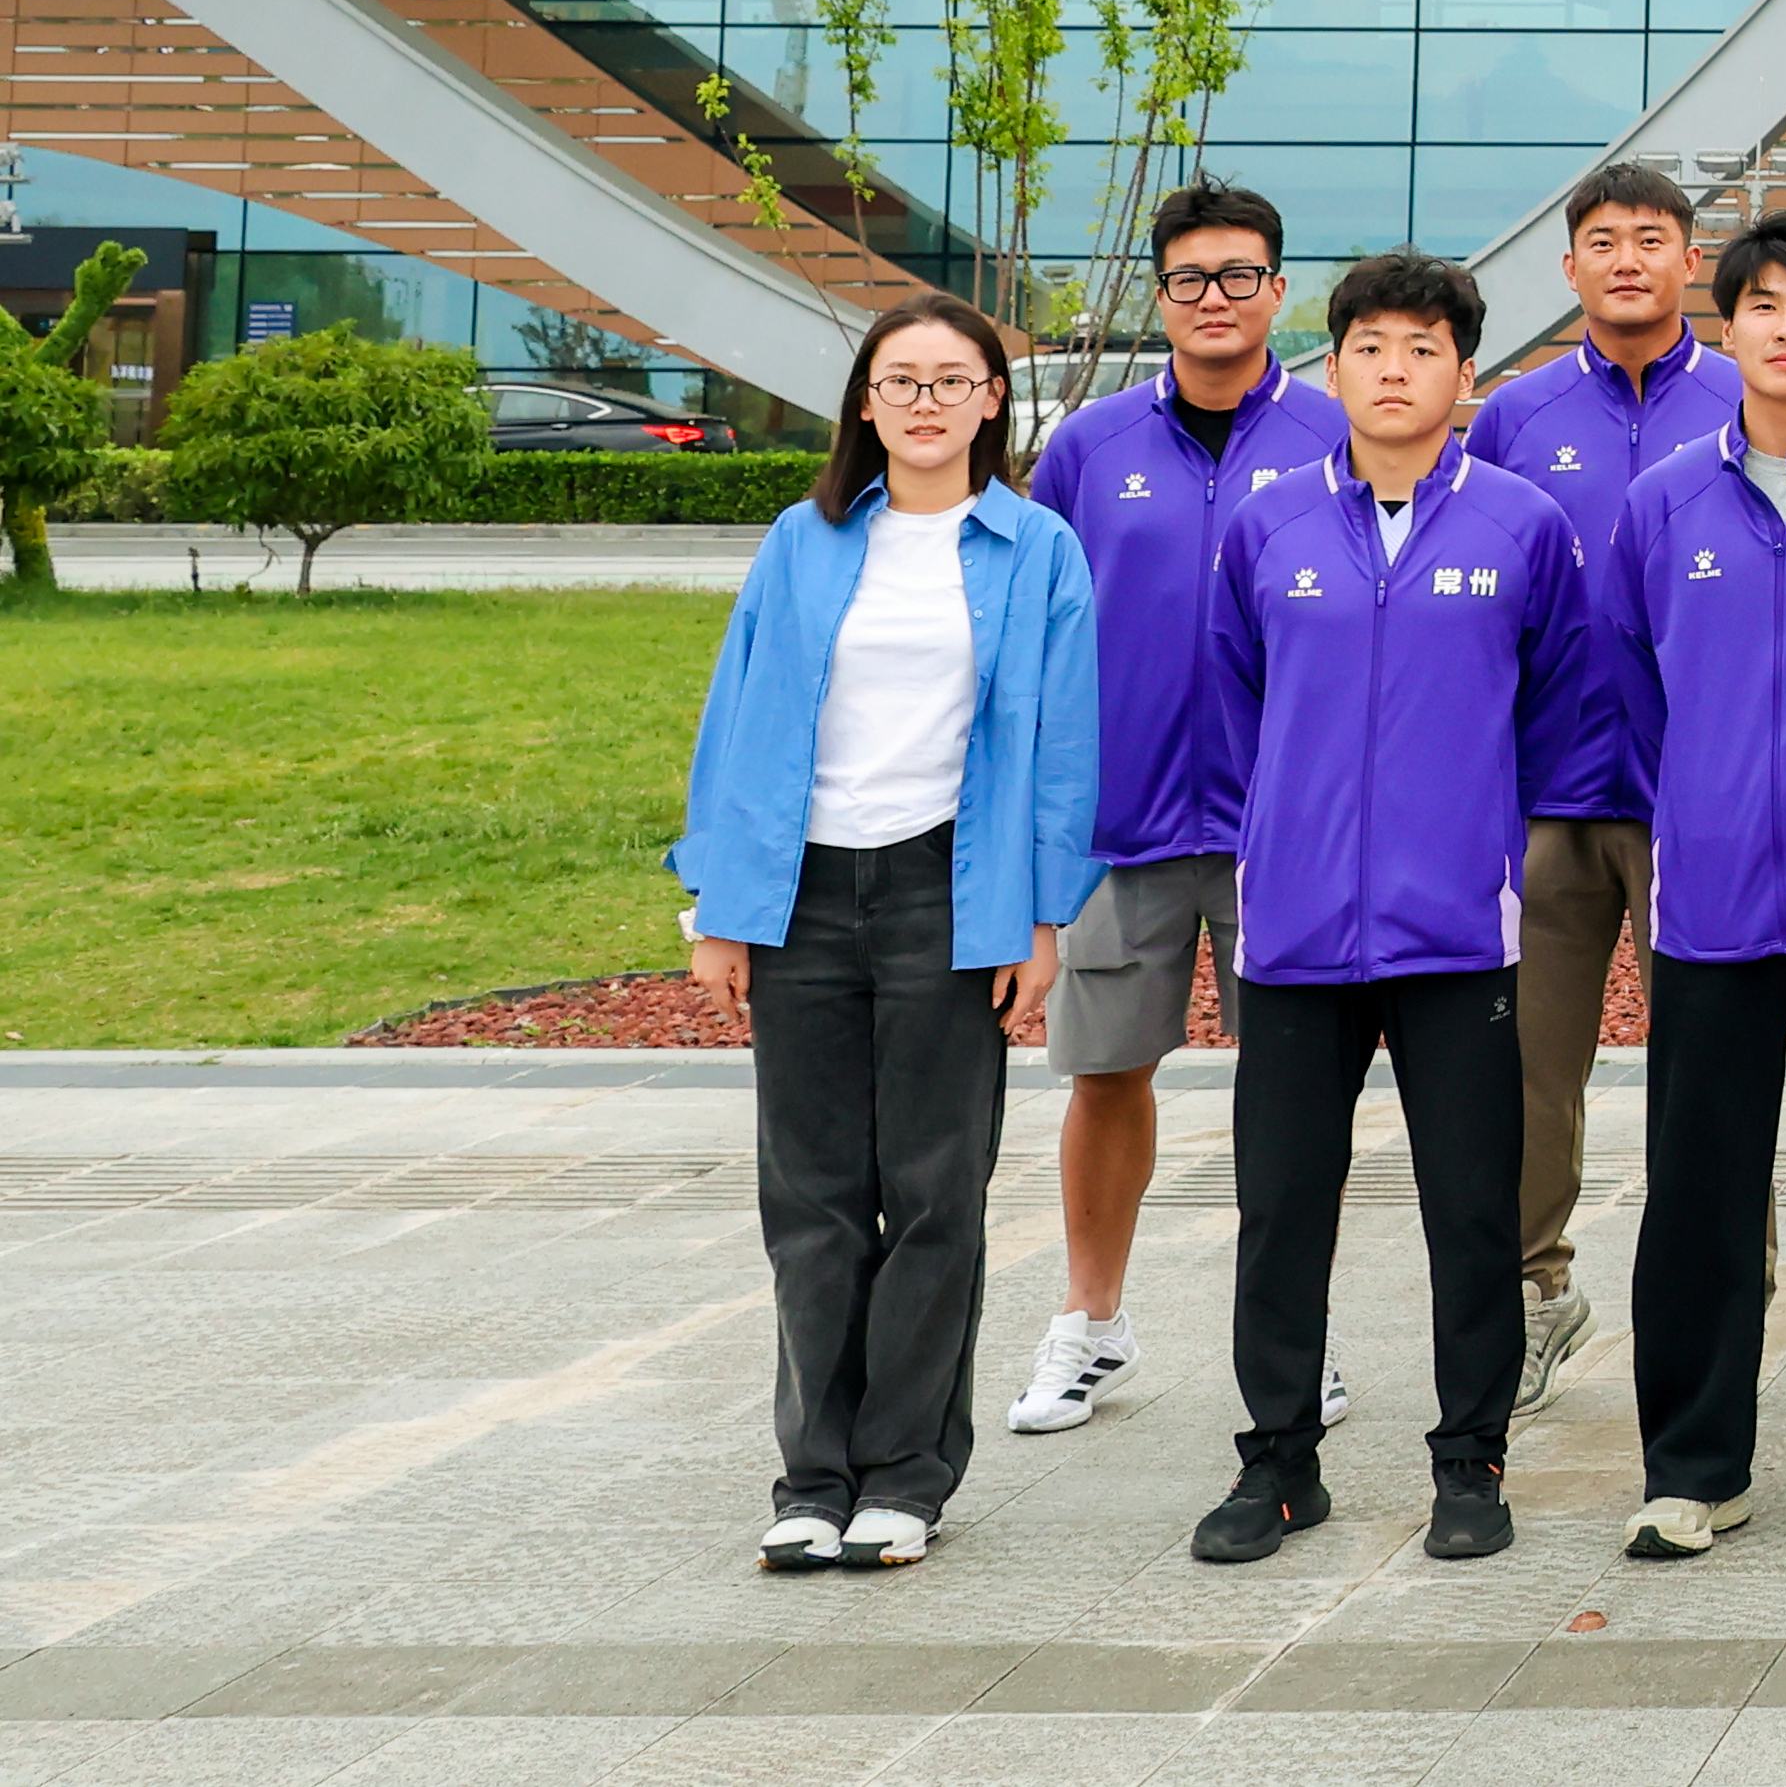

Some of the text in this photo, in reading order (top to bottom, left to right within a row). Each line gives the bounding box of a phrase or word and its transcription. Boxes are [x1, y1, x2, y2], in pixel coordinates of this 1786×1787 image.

[1550, 463, 1582, 471] KELME
[1119, 490, 1151, 499] KELME
[1688, 568, 1722, 579] KELME
[1433, 568, 1498, 596] 常州
[1288, 589, 1323, 598] KELME
